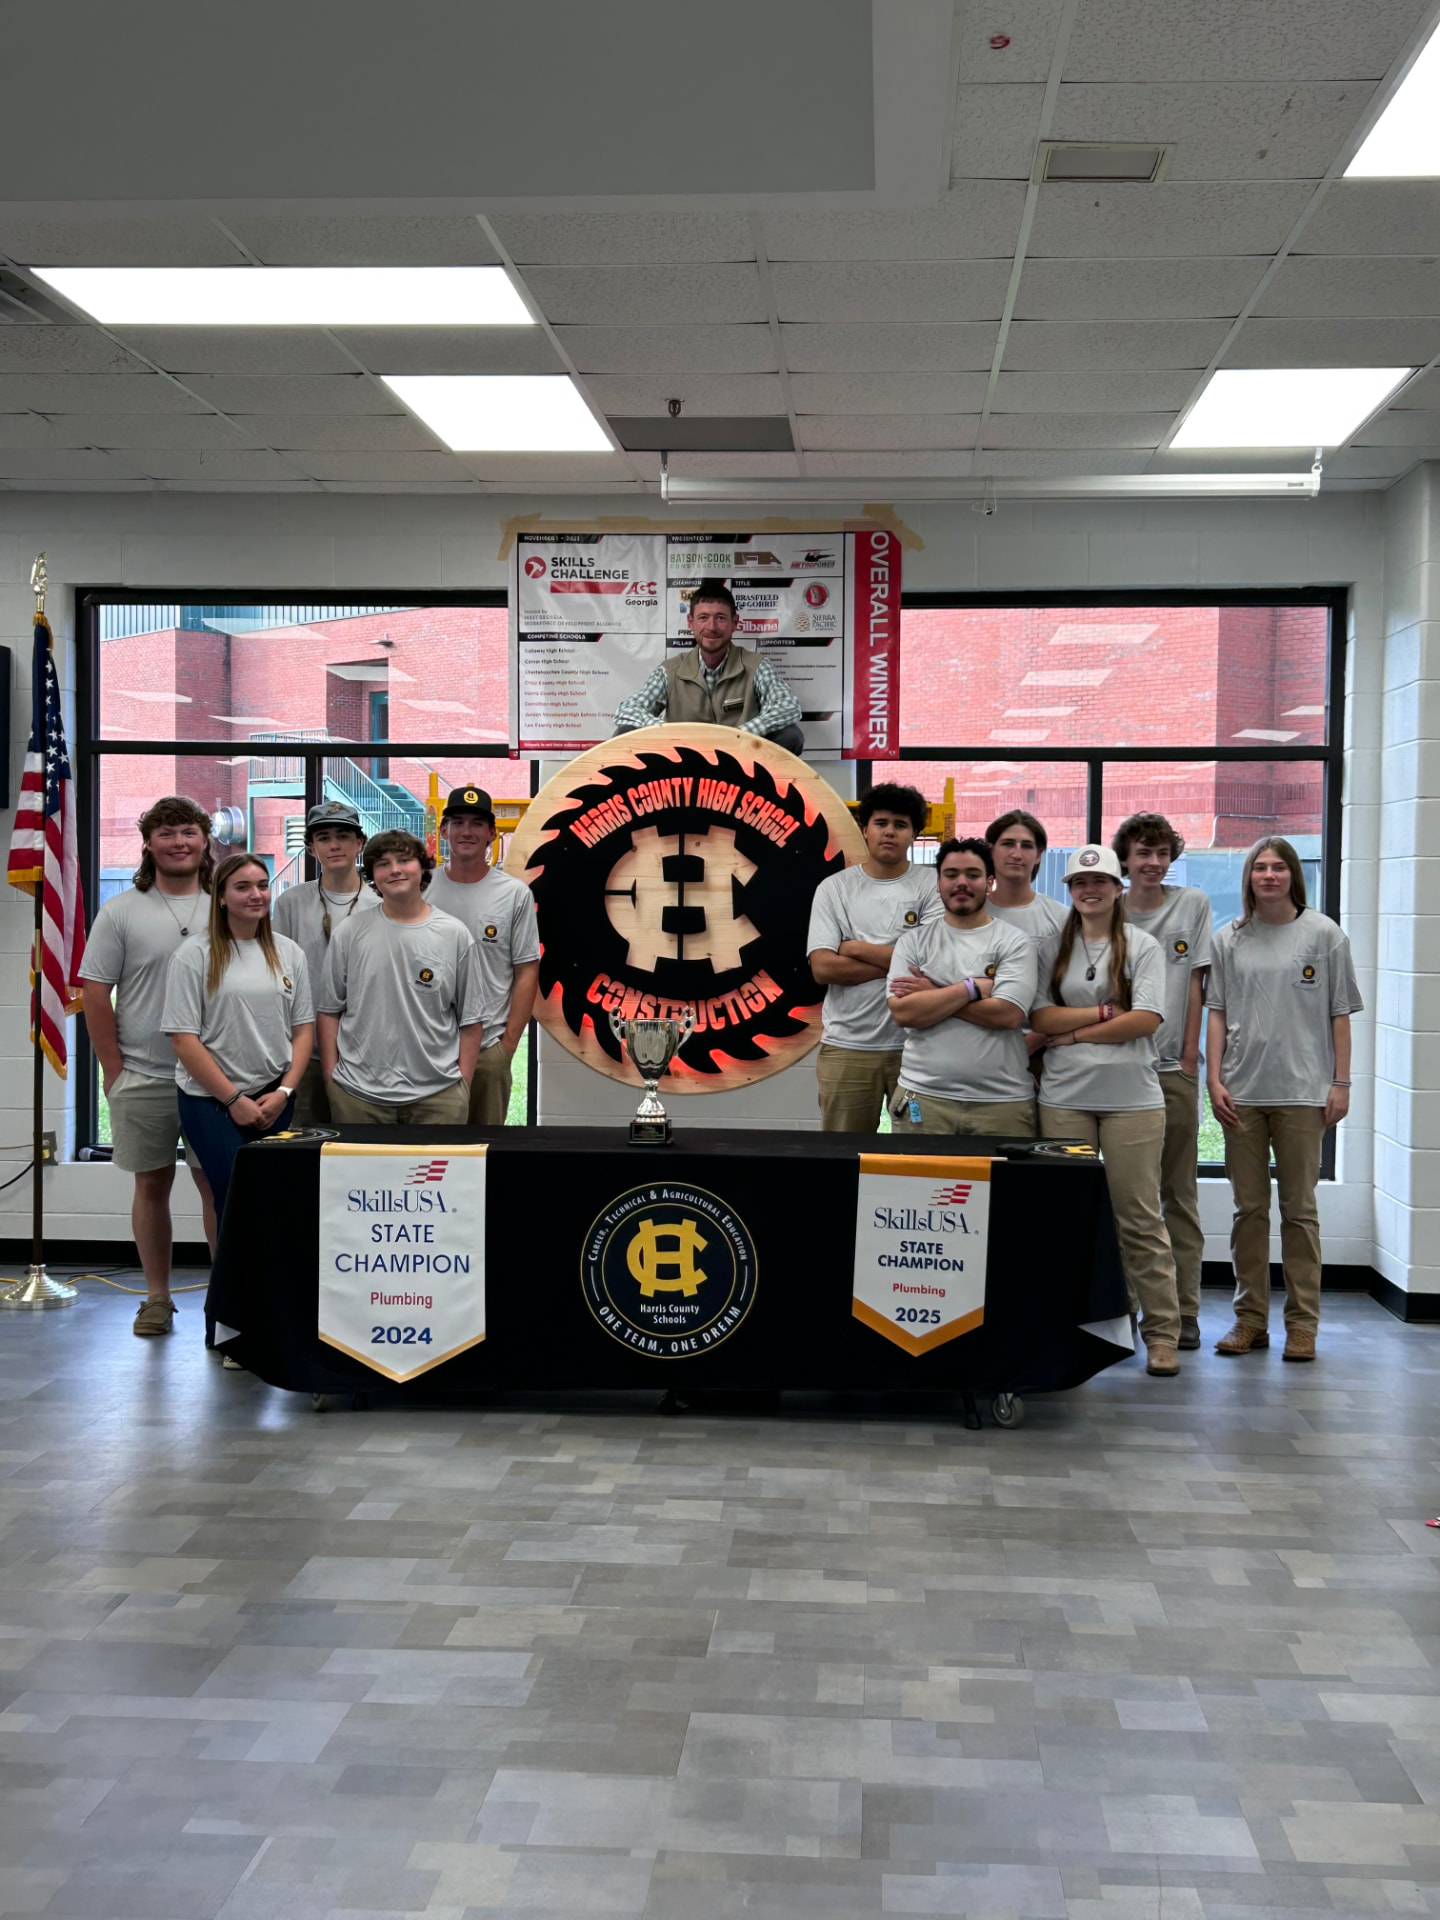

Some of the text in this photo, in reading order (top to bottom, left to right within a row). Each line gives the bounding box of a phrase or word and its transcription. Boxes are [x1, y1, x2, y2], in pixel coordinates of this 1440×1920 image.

[551, 557, 595, 567] SKILLS
[670, 553, 731, 563] BATSON-COOK
[551, 569, 629, 580] CHALLENGE
[626, 581, 657, 595] AGC
[625, 599, 658, 607] Georgia
[735, 594, 779, 602] BRASFIELD
[746, 601, 778, 609] GORRIE
[812, 613, 837, 622] SIERRA
[868, 531, 889, 749] OVERALL WINNER
[569, 777, 800, 849] HARRIS COUNTY HIGH SCHOOL
[586, 968, 784, 1033] CONSTRUCTION
[347, 1189, 449, 1213] SkillsUSA
[649, 1189, 657, 1200] &
[873, 1206, 971, 1234] SkillsUSA
[371, 1224, 435, 1243] STATE
[899, 1240, 944, 1255] STATE
[335, 1253, 470, 1273] CHAMPION
[877, 1254, 964, 1272] CHAMPION
[892, 1282, 946, 1298] Plumbing
[370, 1292, 433, 1309] Plumbing
[640, 1303, 700, 1315] Harris County
[895, 1307, 941, 1324] 2025
[653, 1314, 687, 1324] Schools
[371, 1326, 433, 1345] 2024
[599, 1305, 742, 1354] ONE TEAM, ONE DREAM
